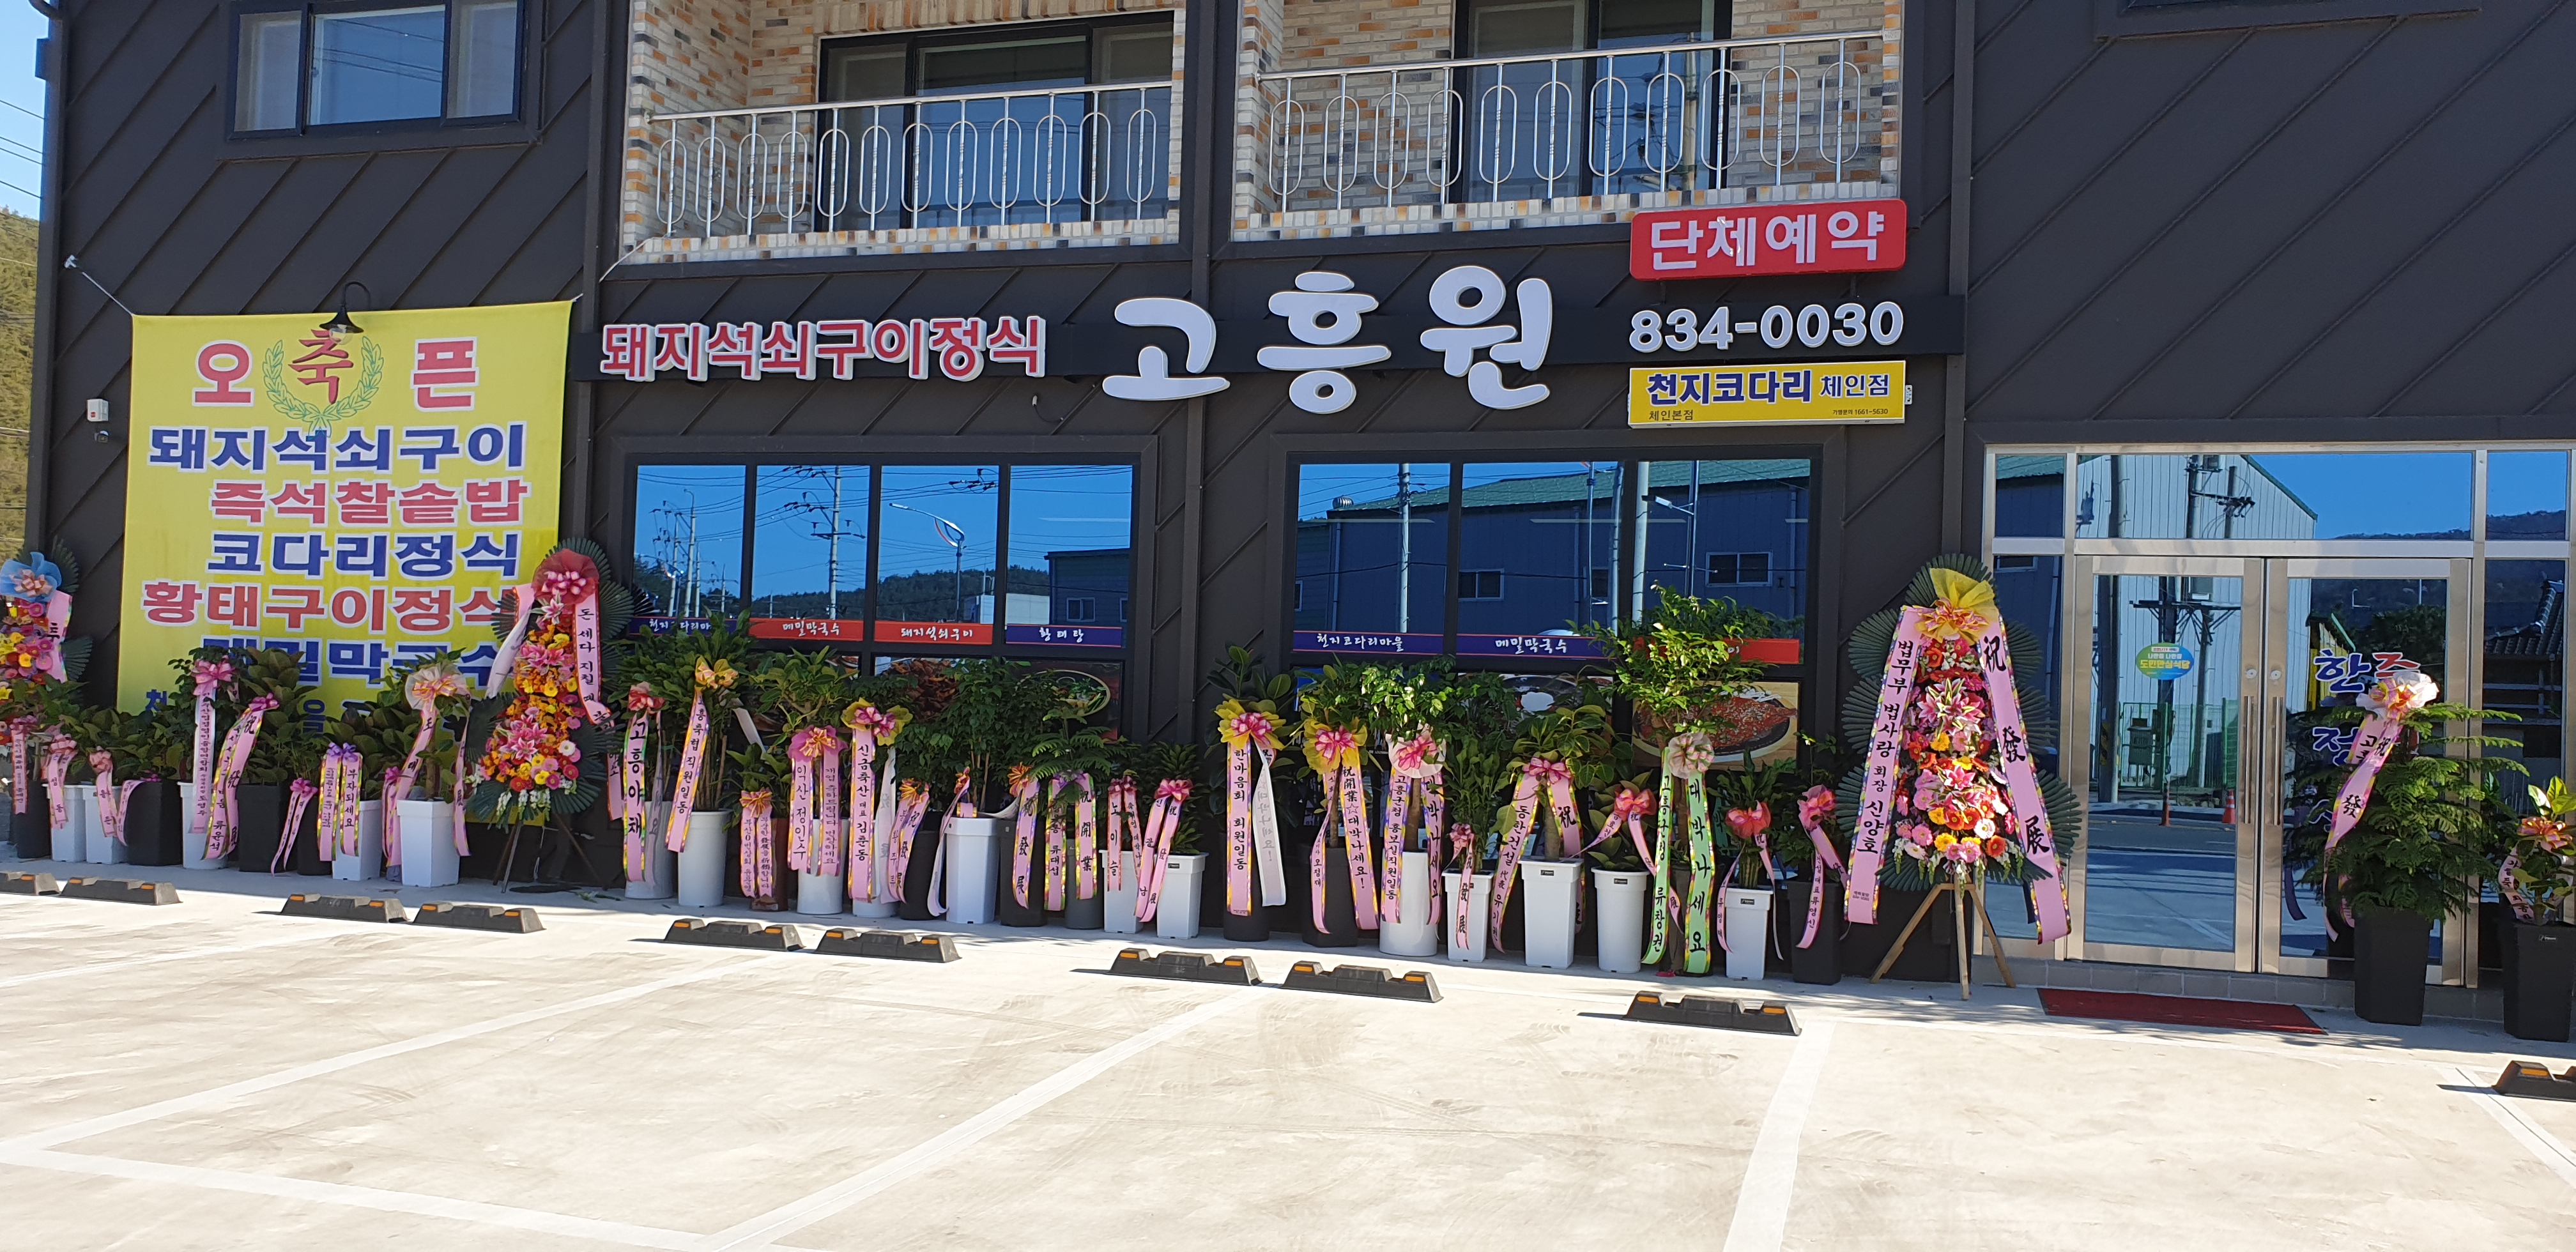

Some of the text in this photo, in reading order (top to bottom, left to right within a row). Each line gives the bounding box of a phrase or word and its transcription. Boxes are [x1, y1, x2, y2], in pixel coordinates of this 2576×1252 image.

[1651, 211, 1884, 270] 단체예약
[601, 314, 1048, 381] 돼지석쇠구이정식
[1102, 265, 1552, 413] 고흥원
[1629, 302, 1904, 353] 834-0030
[1646, 370, 1890, 406] 천지코다리 체인점
[1648, 409, 1694, 421] 체인본점
[149, 423, 527, 473] 돼지석쇠구이
[210, 477, 531, 528] 즉석찰솥밥
[206, 531, 523, 582] 코다리정식
[578, 609, 594, 620] 돈
[649, 618, 712, 633] 천지다리마
[782, 621, 841, 637] 메밀막국수
[900, 625, 974, 642] 돼지석쇠구이
[578, 628, 595, 653] 세다
[1316, 633, 1404, 652] 천지코다리마을
[1495, 637, 1568, 655] 메밀막국수
[1856, 640, 1913, 854] 법무부 법사랑 회장 신양호
[344, 768, 358, 827] 부자되세요
[628, 721, 646, 839] 고흥아채
[677, 756, 697, 814] 직원일동
[1391, 775, 1406, 817] 고흥군청
[793, 765, 809, 860] 익산 정인수
[859, 802, 867, 818] 대표
[1234, 749, 1247, 871] 한마음회 회원일동
[1110, 802, 1119, 876] 노이슬
[1689, 779, 1711, 952] 대박나세요
[1652, 887, 1666, 951] 류창권
